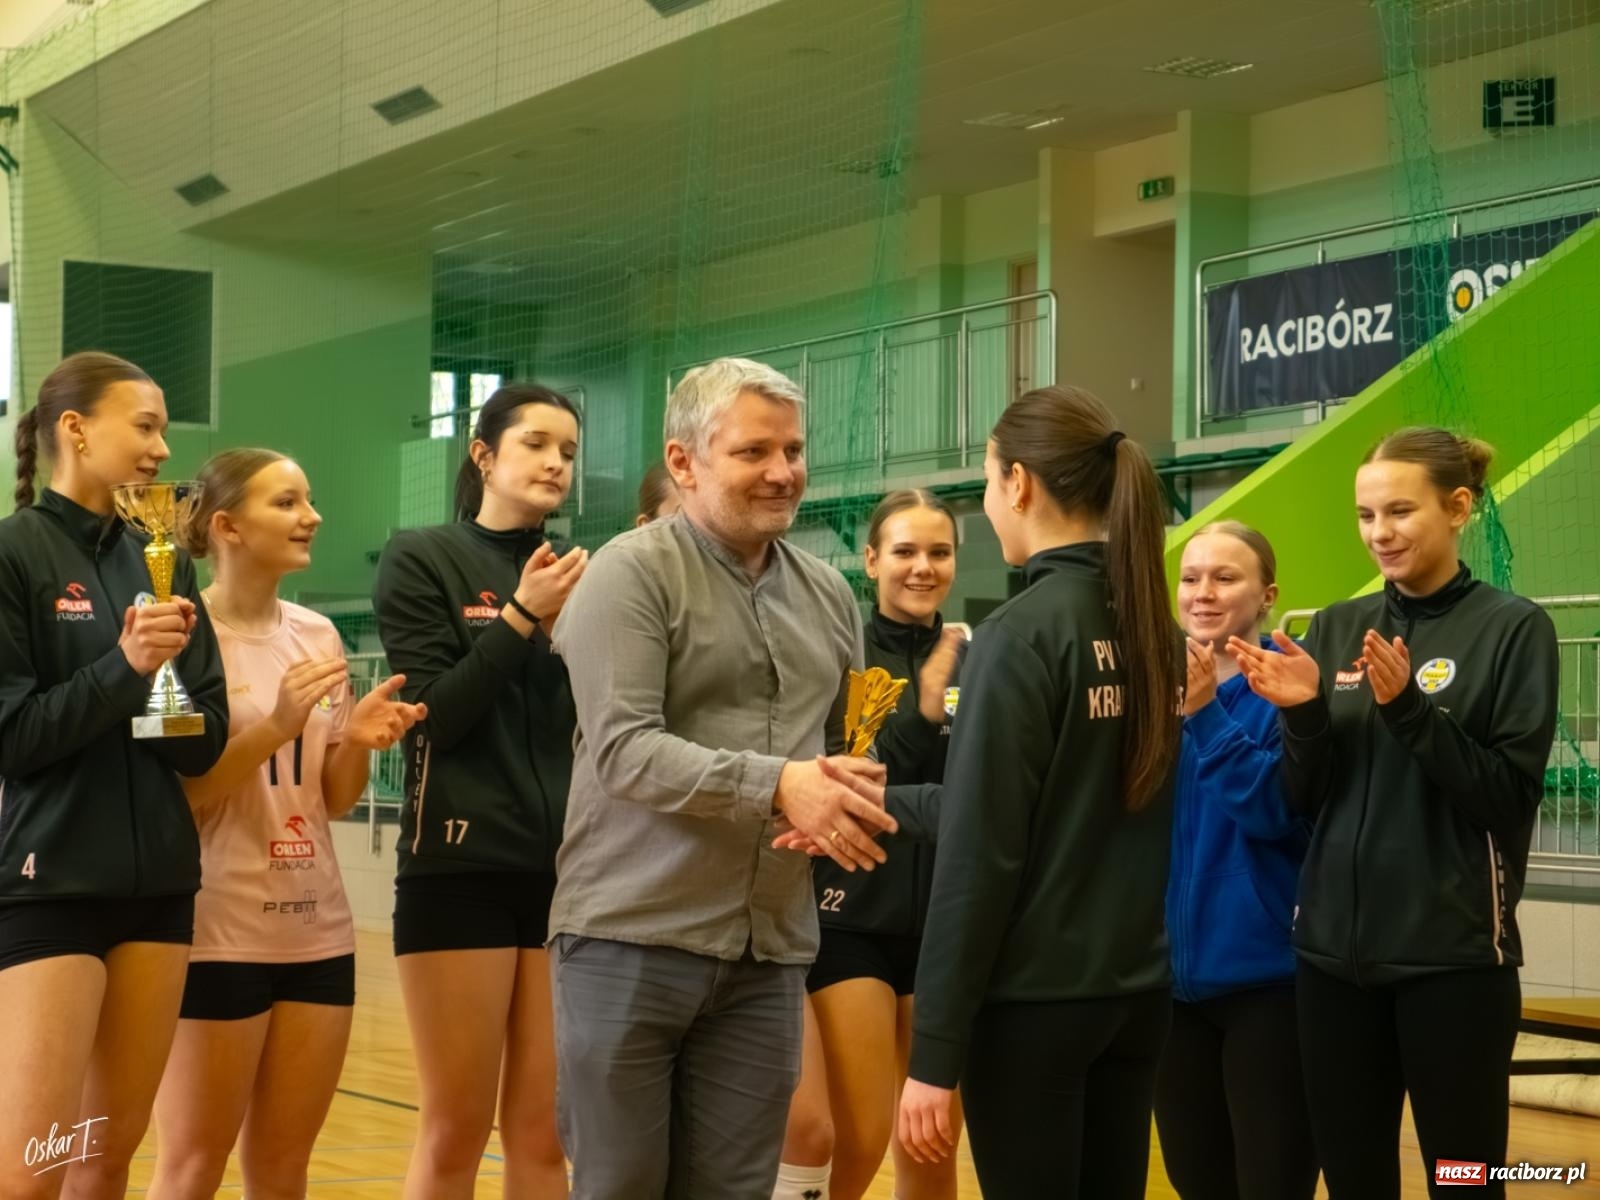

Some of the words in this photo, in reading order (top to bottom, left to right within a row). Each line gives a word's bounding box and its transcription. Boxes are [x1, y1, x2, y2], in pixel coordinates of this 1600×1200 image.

[1502, 94, 1535, 122] E
[1241, 297, 1393, 364] RACIBÓRZ
[444, 819, 469, 844] 17
[21, 852, 36, 880] 4
[820, 888, 845, 912] 22
